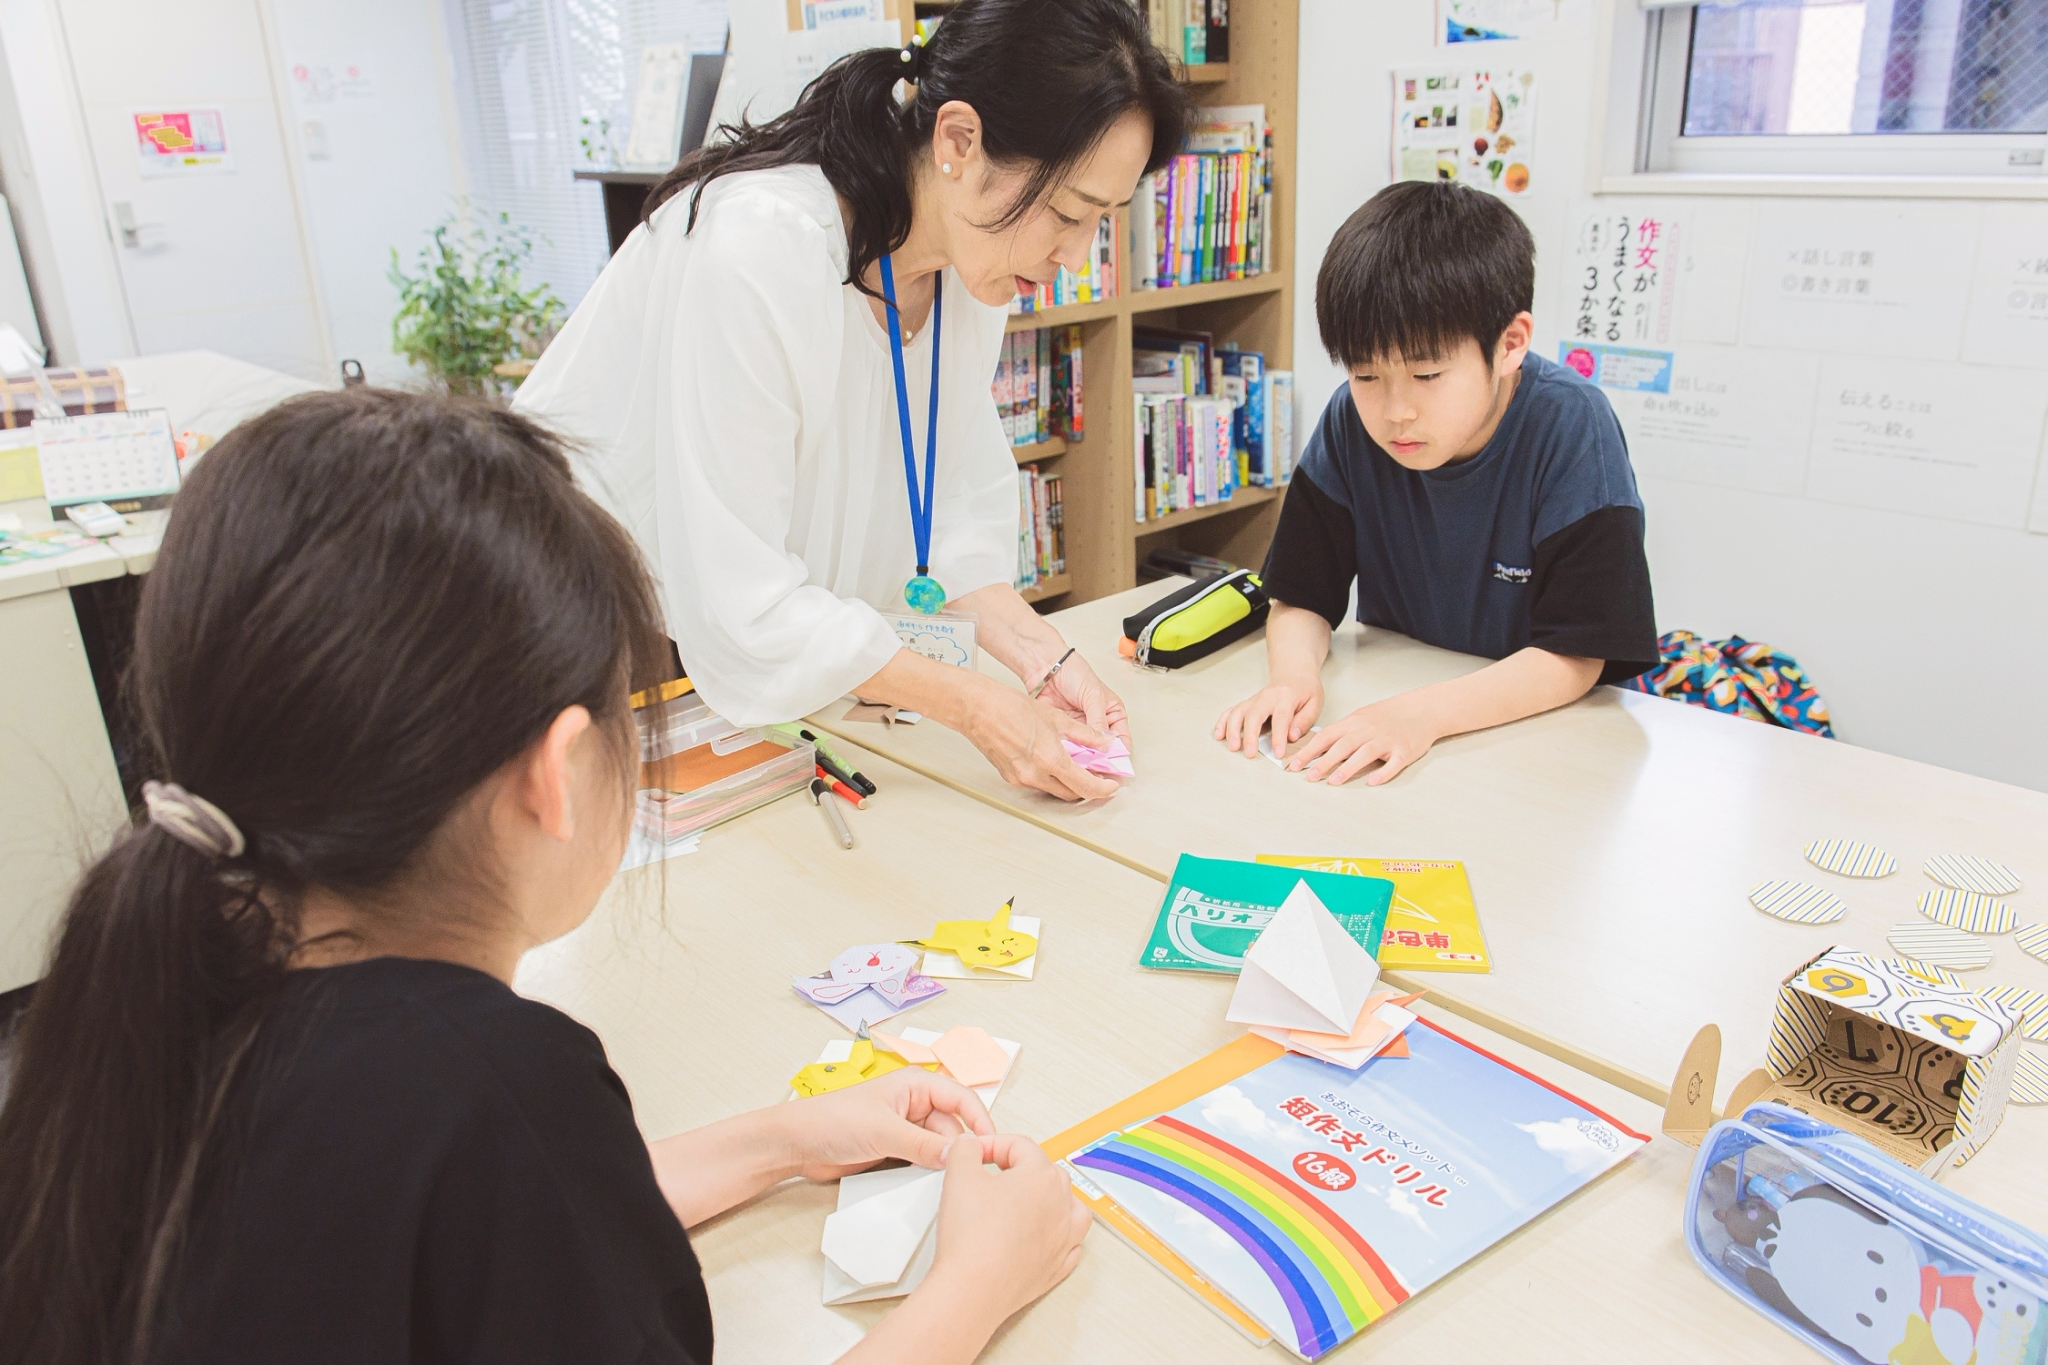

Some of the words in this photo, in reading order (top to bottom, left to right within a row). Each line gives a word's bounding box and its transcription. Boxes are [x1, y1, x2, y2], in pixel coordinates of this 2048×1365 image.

[1606, 216, 1630, 342] うまくなる
[1633, 216, 1662, 293] 作文が
[1845, 1019, 1879, 1063] 7
[1931, 1013, 1971, 1041] 3
[1320, 1091, 1456, 1173] あおぞら作文メソッド
[1842, 1090, 1898, 1124] 10
[1279, 1097, 1448, 1206] 短作文ドリル
[1298, 1153, 1351, 1190] 16級
